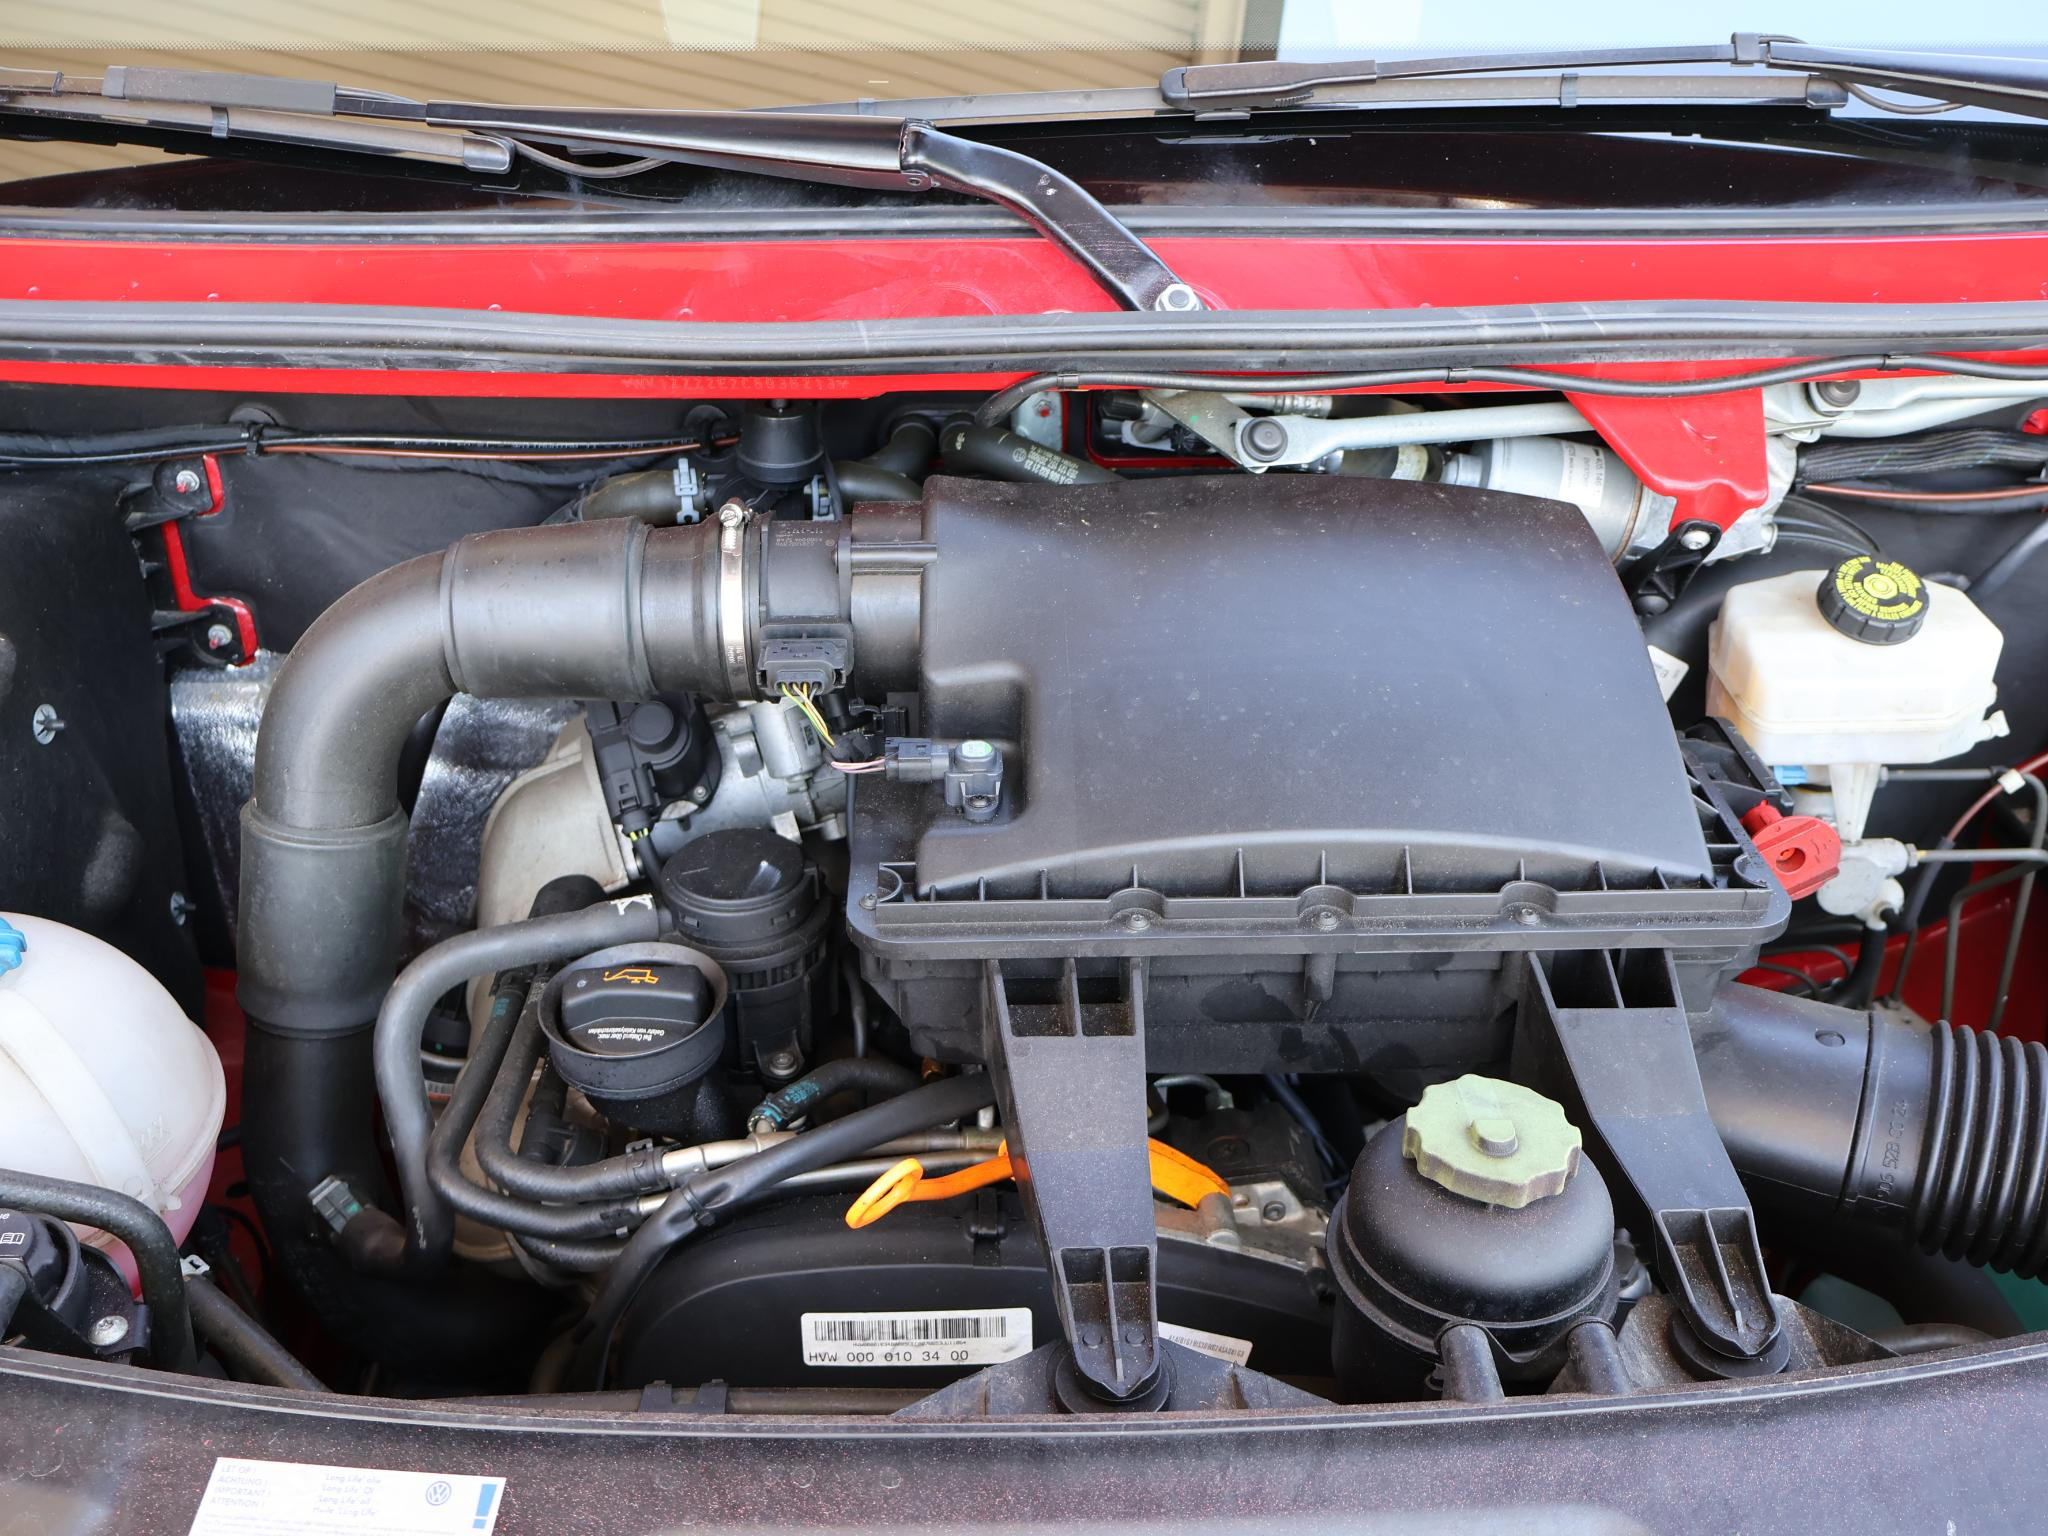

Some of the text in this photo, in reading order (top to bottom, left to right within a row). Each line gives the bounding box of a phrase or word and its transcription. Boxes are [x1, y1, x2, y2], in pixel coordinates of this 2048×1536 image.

[808, 1350, 969, 1363] HVW 000 010 34 00
[217, 1476, 263, 1486] ACHTUNG
[214, 1486, 266, 1496] IMPORTANT
[209, 1496, 259, 1507] ATTENTION
